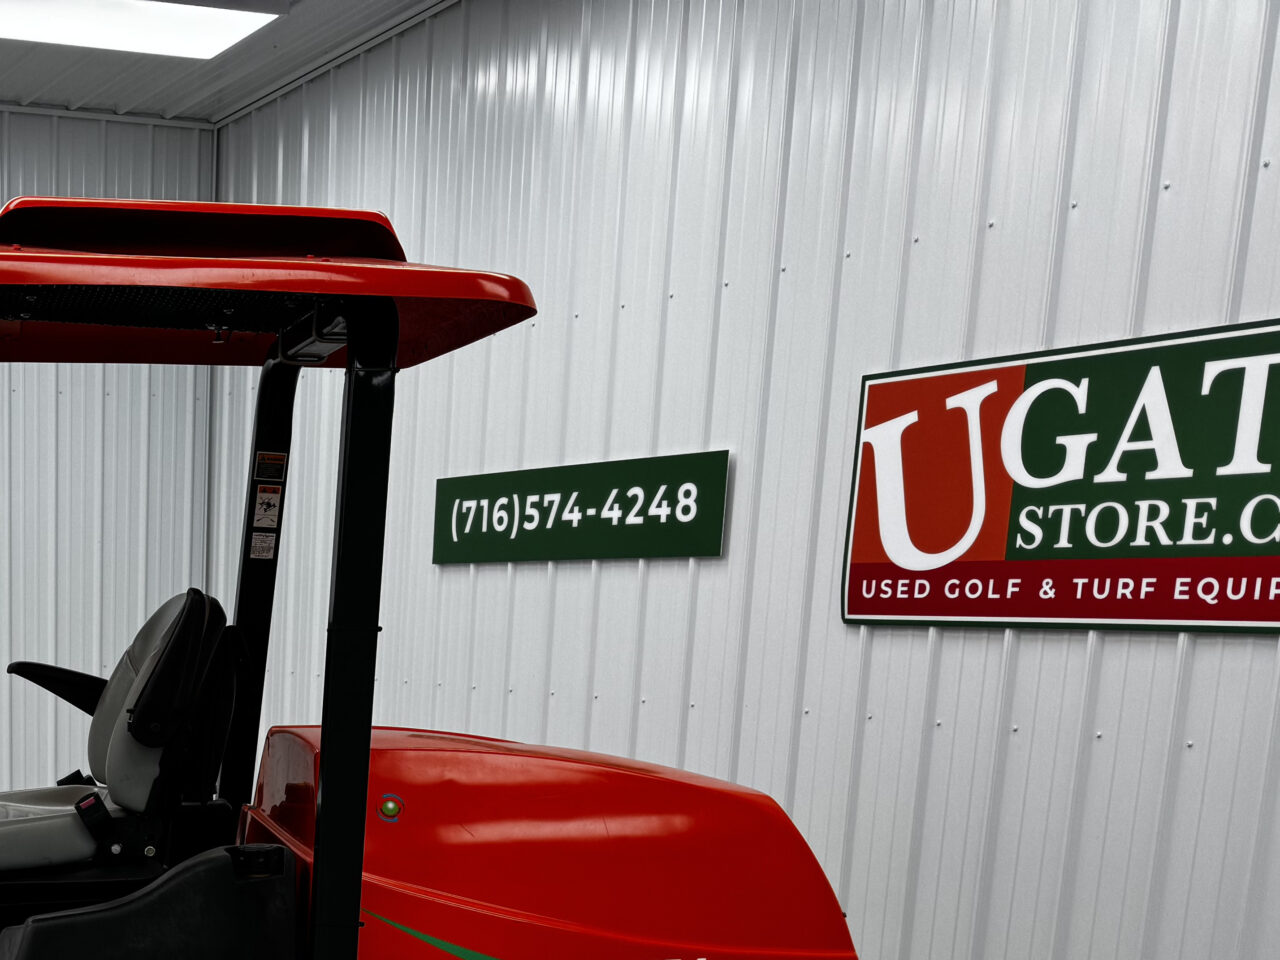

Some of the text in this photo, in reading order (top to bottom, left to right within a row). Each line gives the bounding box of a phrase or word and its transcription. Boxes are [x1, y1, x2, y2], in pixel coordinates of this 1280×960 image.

[451, 482, 698, 542] (716)574-4248
[862, 578, 931, 599] USED
[944, 578, 1022, 600] GOLF
[1039, 578, 1056, 599] &
[1073, 577, 1157, 600] TURF
